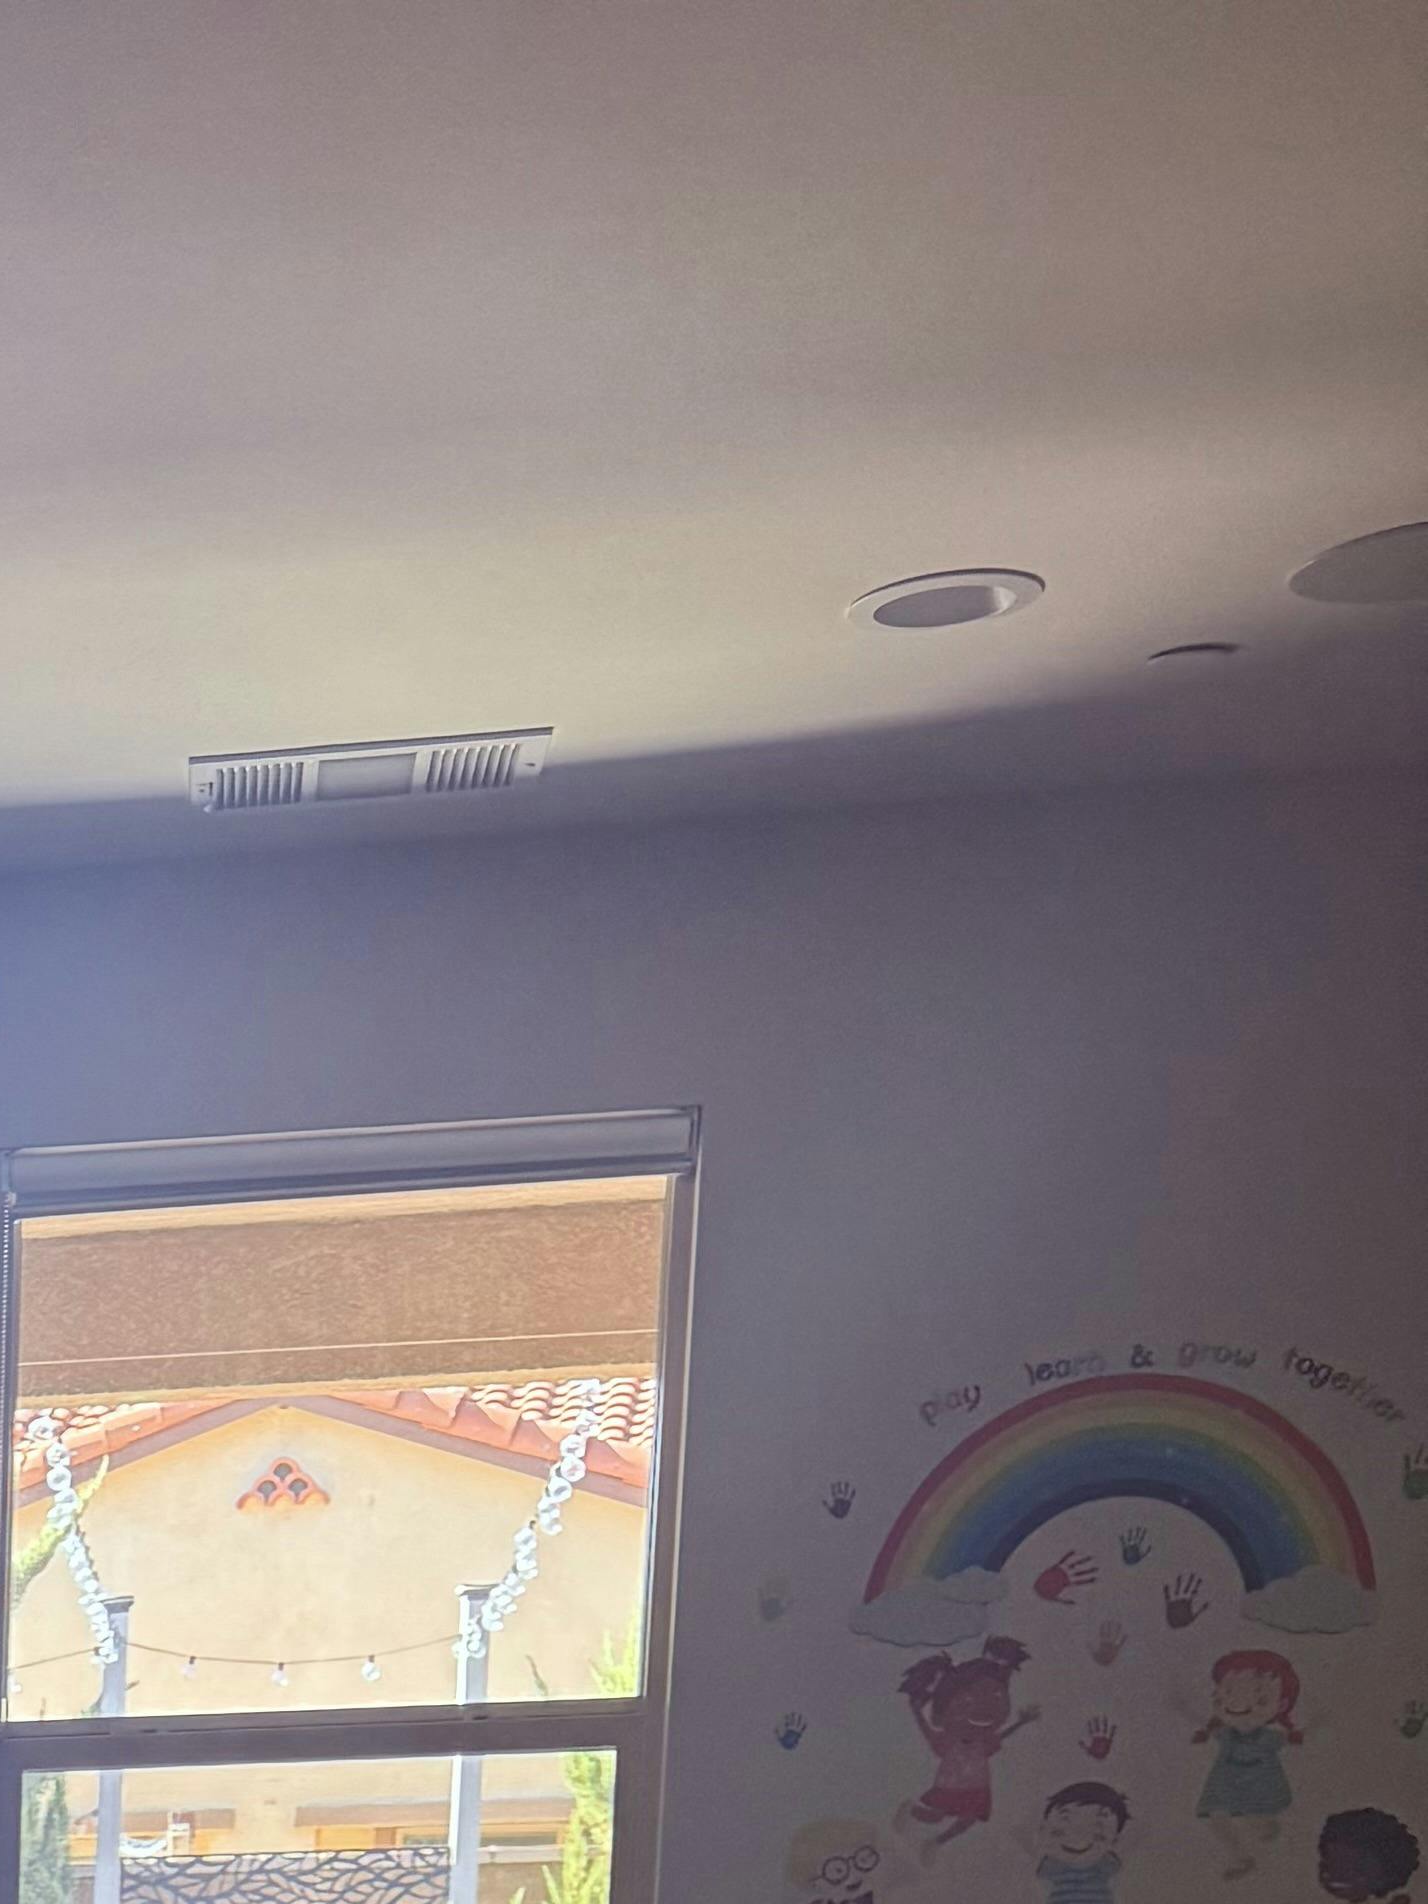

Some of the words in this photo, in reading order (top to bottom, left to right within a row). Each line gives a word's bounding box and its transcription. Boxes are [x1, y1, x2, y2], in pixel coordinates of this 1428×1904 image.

[918, 1382, 982, 1428] play
[1022, 1351, 1108, 1387] learn
[1128, 1344, 1156, 1369] &
[1176, 1341, 1260, 1369] grow
[1281, 1345, 1406, 1424] together
